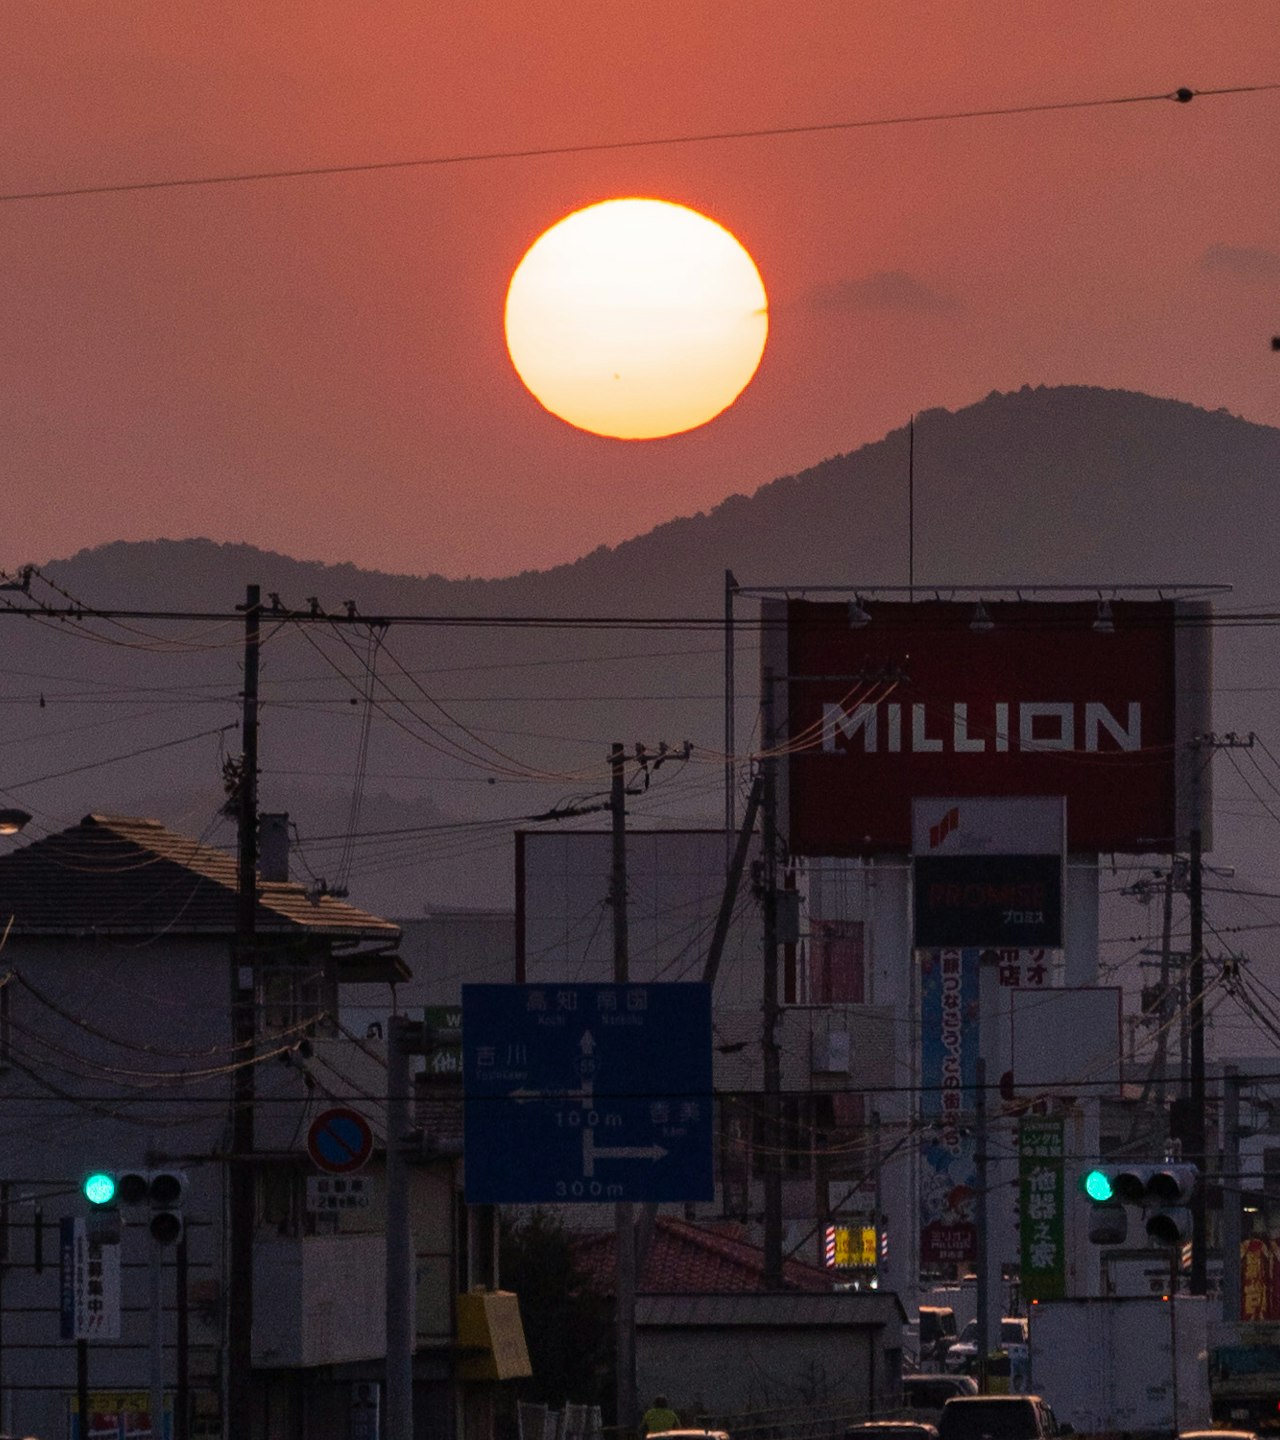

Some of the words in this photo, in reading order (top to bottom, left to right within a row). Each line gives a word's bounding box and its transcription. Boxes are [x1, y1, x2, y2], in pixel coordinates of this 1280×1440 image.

[822, 701, 1142, 752] MILLION
[526, 989, 579, 1012] 高知
[596, 989, 648, 1012] 南国
[476, 1044, 529, 1068] 吉川
[554, 1109, 623, 1127] 100m
[554, 1179, 624, 1197] 300m
